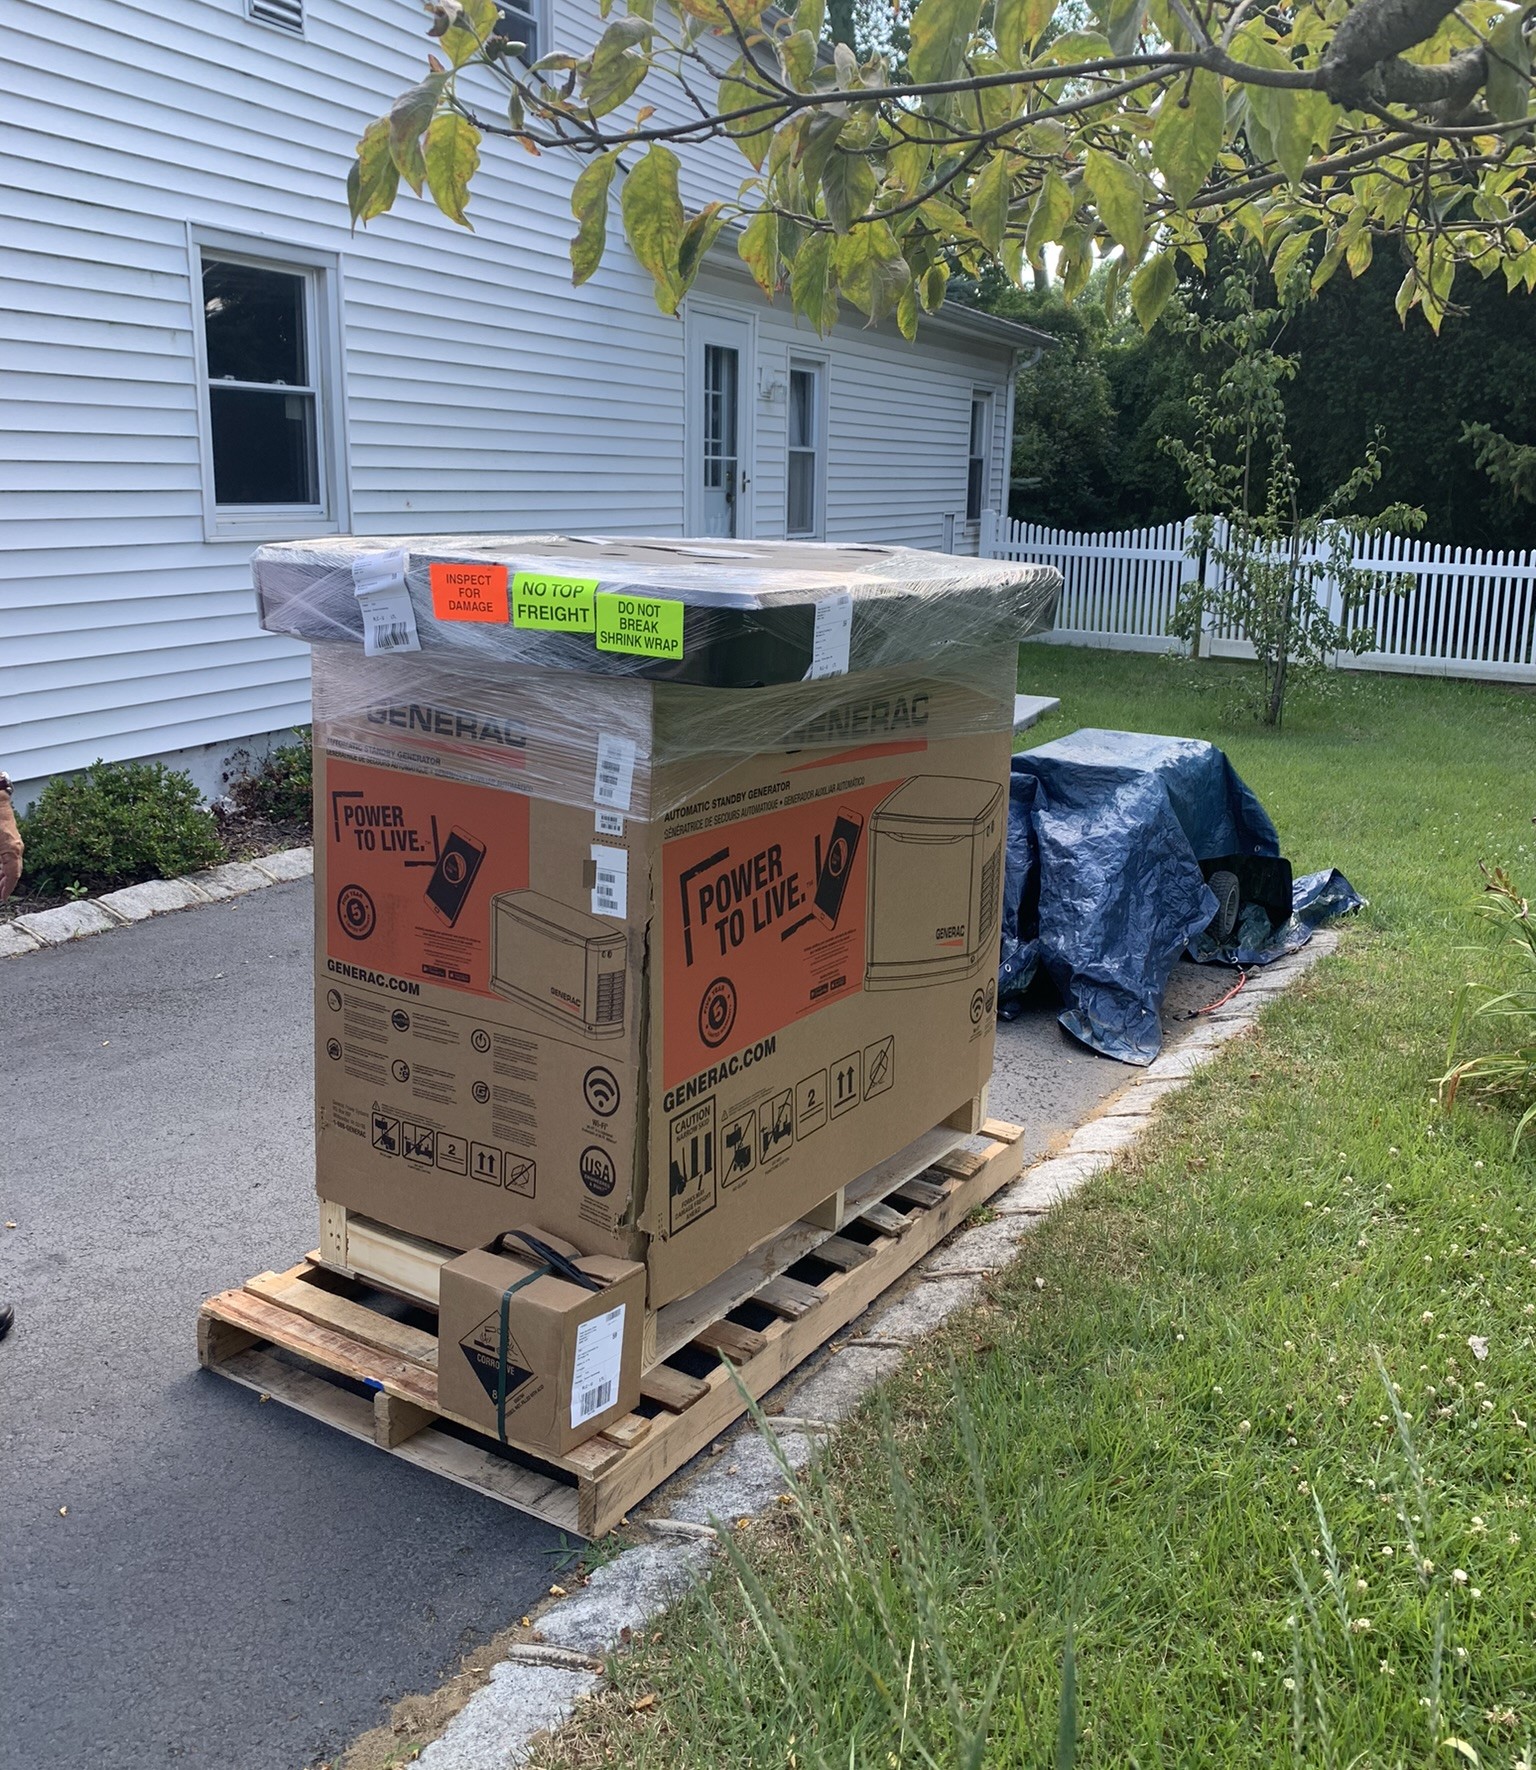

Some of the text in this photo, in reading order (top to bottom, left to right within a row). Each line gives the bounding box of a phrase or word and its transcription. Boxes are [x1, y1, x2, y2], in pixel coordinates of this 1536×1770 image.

[446, 573, 492, 586] INSPECT
[459, 587, 481, 599] FOR
[522, 581, 584, 599] NO TOP
[448, 600, 494, 613] DAMAGE
[517, 604, 590, 623] FREIGHT
[618, 601, 662, 618] DO NOT
[620, 618, 659, 634] BREAK
[600, 631, 678, 652] SHRINK WRAP
[664, 780, 791, 822] AUTOMATIC STANDBY GENERATOR
[344, 805, 405, 827] POWER
[714, 809, 740, 826] SECOURS
[354, 830, 425, 852] TO LIVE.
[699, 844, 783, 926] POWER
[351, 902, 362, 920] 5
[714, 908, 745, 956] TO
[752, 872, 806, 933] LIVE.
[936, 924, 965, 940] GENERAC
[327, 959, 420, 996] GENERAC.COM
[550, 986, 582, 1008] GENERAC
[713, 1000, 724, 1022] 5
[663, 1035, 776, 1114] GENERAC.COM
[808, 1088, 816, 1108] 2
[675, 1104, 710, 1134] CAUTION
[676, 1125, 698, 1144] NARROW
[448, 1144, 456, 1156] 2
[585, 1156, 610, 1182] USA
[476, 1353, 515, 1376] CORROVE
[492, 1390, 498, 1400] 8
